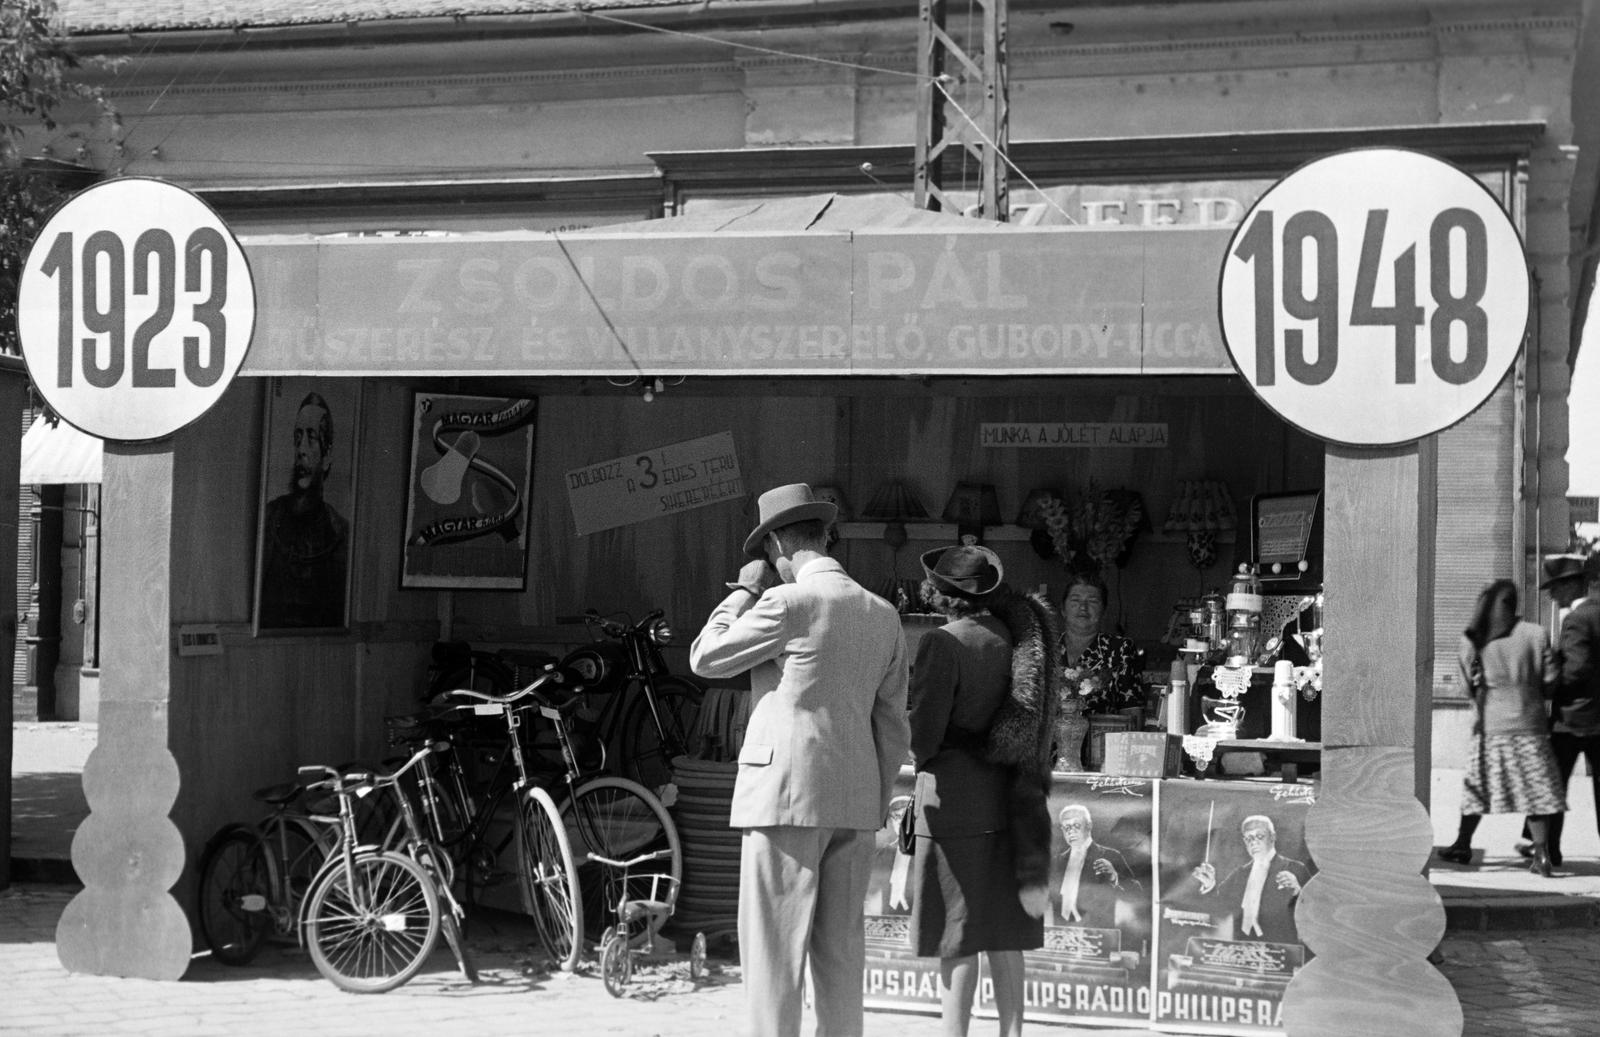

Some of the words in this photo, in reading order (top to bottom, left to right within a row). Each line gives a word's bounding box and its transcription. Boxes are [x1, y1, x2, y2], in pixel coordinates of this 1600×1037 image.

[396, 252, 803, 312] ZSOLDOS
[866, 235, 1028, 310] PÁL
[40, 227, 228, 389] 1923
[1233, 207, 1488, 387] 1948
[522, 316, 569, 361] ÉS
[437, 412, 493, 425] MAGYAR
[984, 425, 1031, 443] MUNKA
[1038, 425, 1047, 443] A
[1108, 425, 1166, 443] ALAPJA
[636, 456, 659, 490] 3
